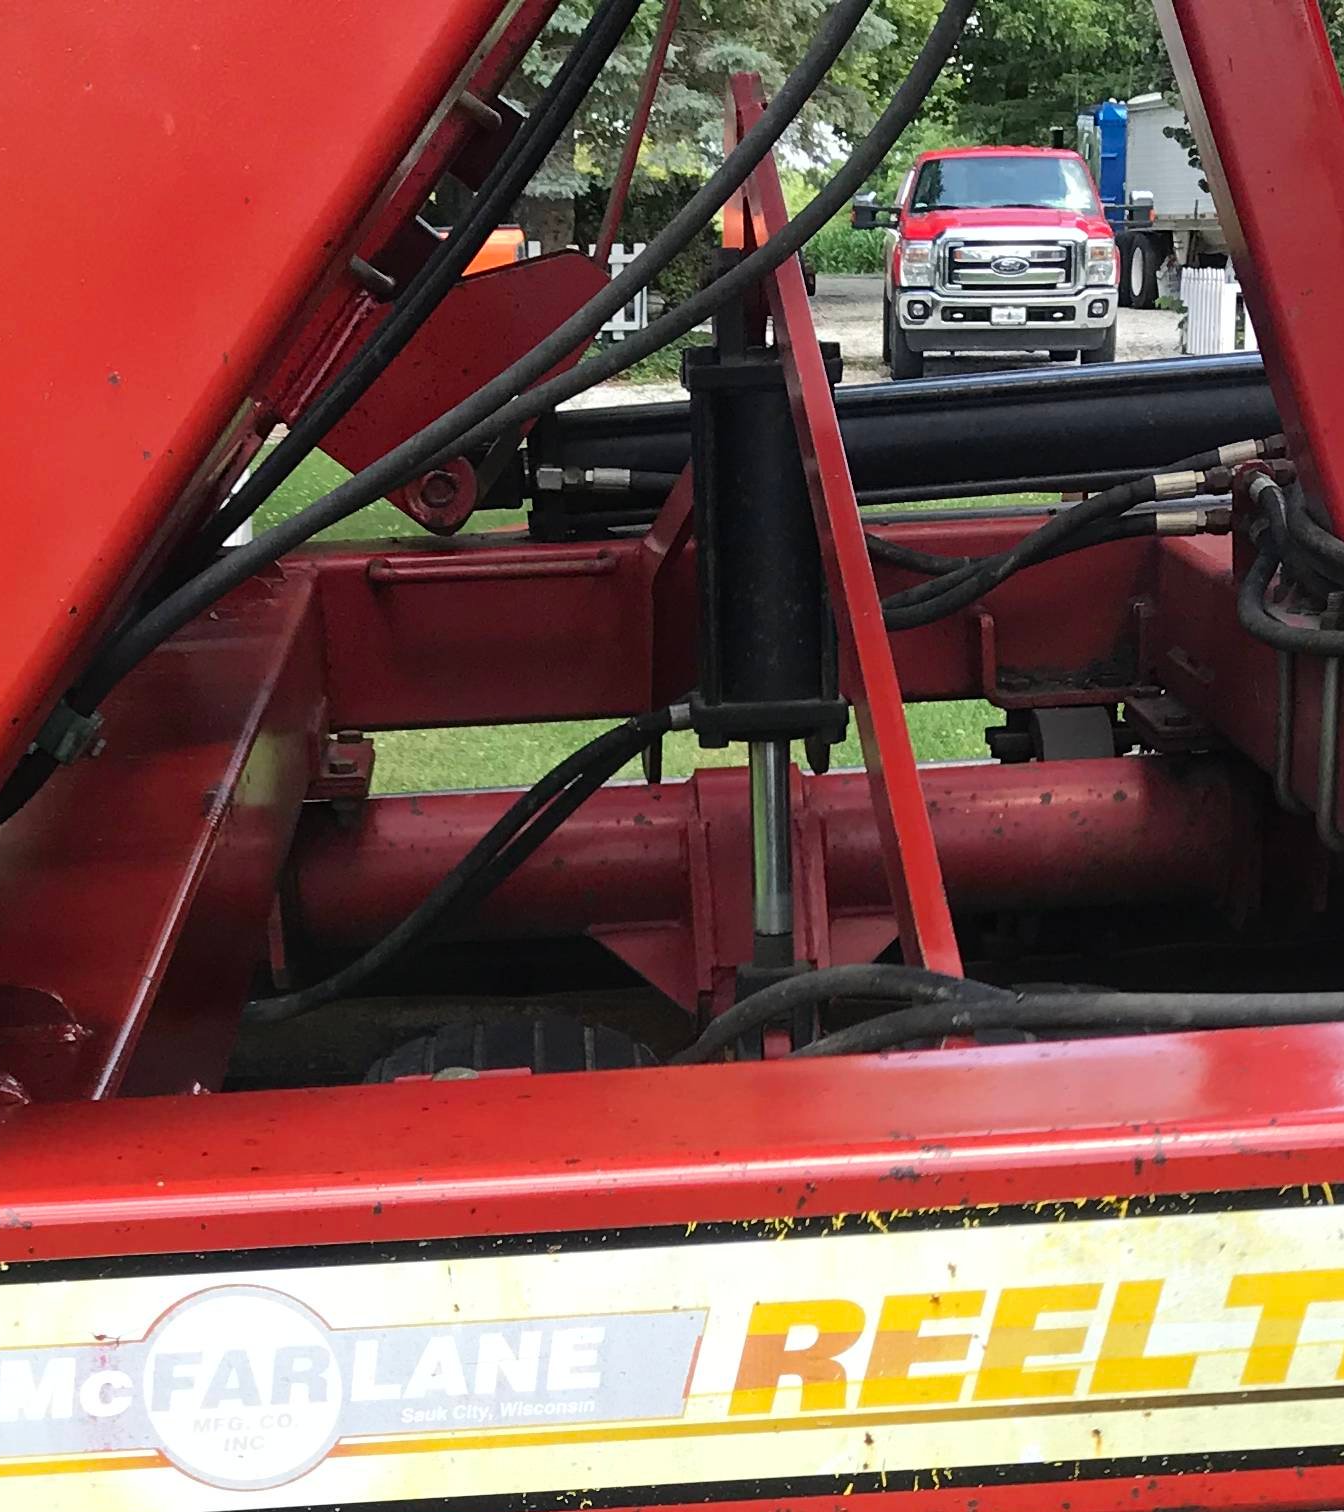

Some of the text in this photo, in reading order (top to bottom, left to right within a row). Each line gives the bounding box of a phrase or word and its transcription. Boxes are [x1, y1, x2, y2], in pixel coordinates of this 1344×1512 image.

[400, 1400, 595, 1424] Sauk City, Wisconsin
[192, 1416, 252, 1433] MFG.
